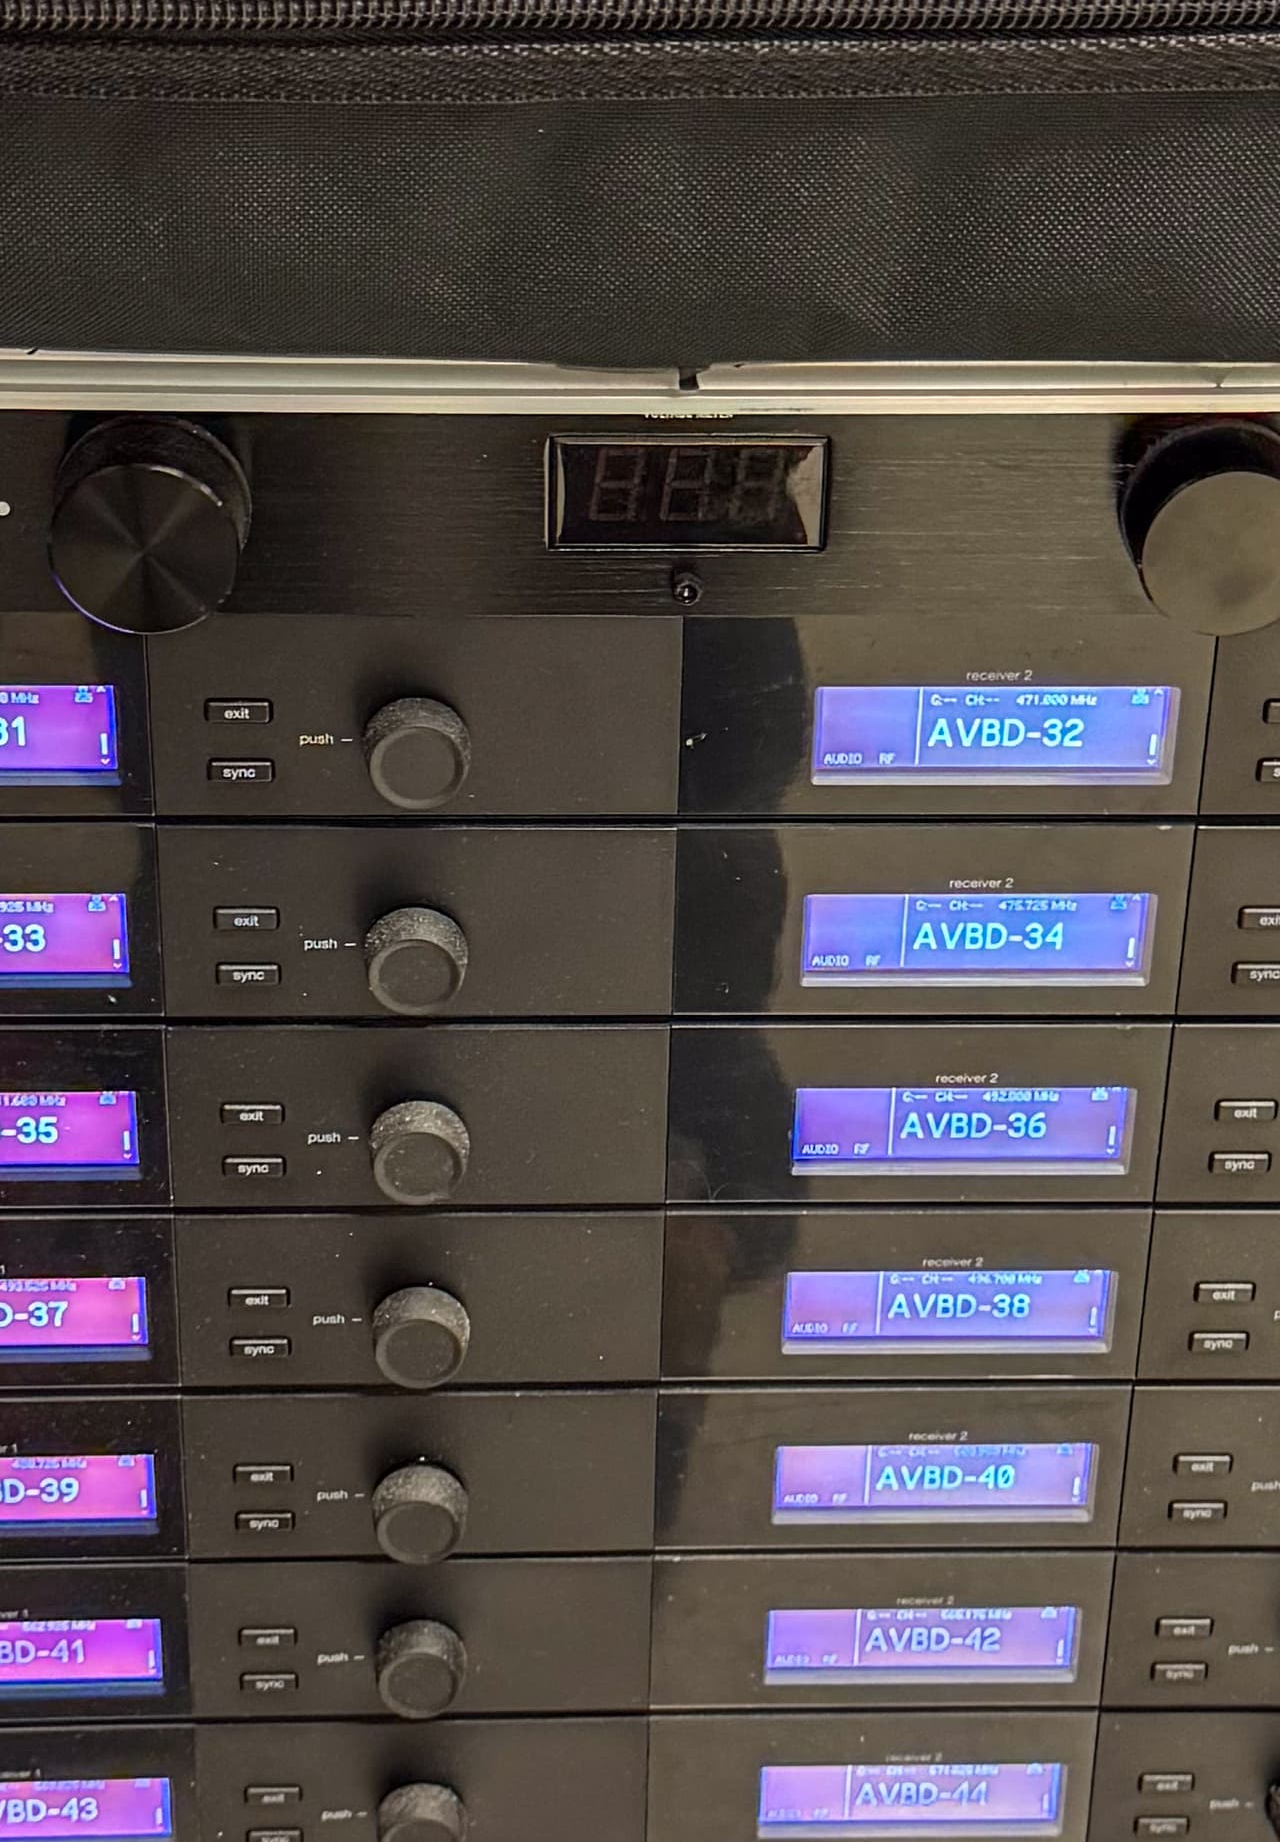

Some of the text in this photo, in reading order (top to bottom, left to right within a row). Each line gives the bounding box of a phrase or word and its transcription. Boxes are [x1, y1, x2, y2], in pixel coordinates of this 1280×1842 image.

[966, 670, 1033, 681] receiver 2
[224, 707, 250, 719] exit
[299, 731, 334, 747] push
[927, 717, 1085, 747] AVBD-32
[222, 766, 256, 781] sync
[912, 922, 1065, 951] AVBD-34
[899, 1111, 1047, 1139] AVBD-36
[887, 1293, 1031, 1319] AVBD-38
[875, 1464, 1015, 1491] AVBD-40
[864, 1626, 1001, 1653] AVBD-42
